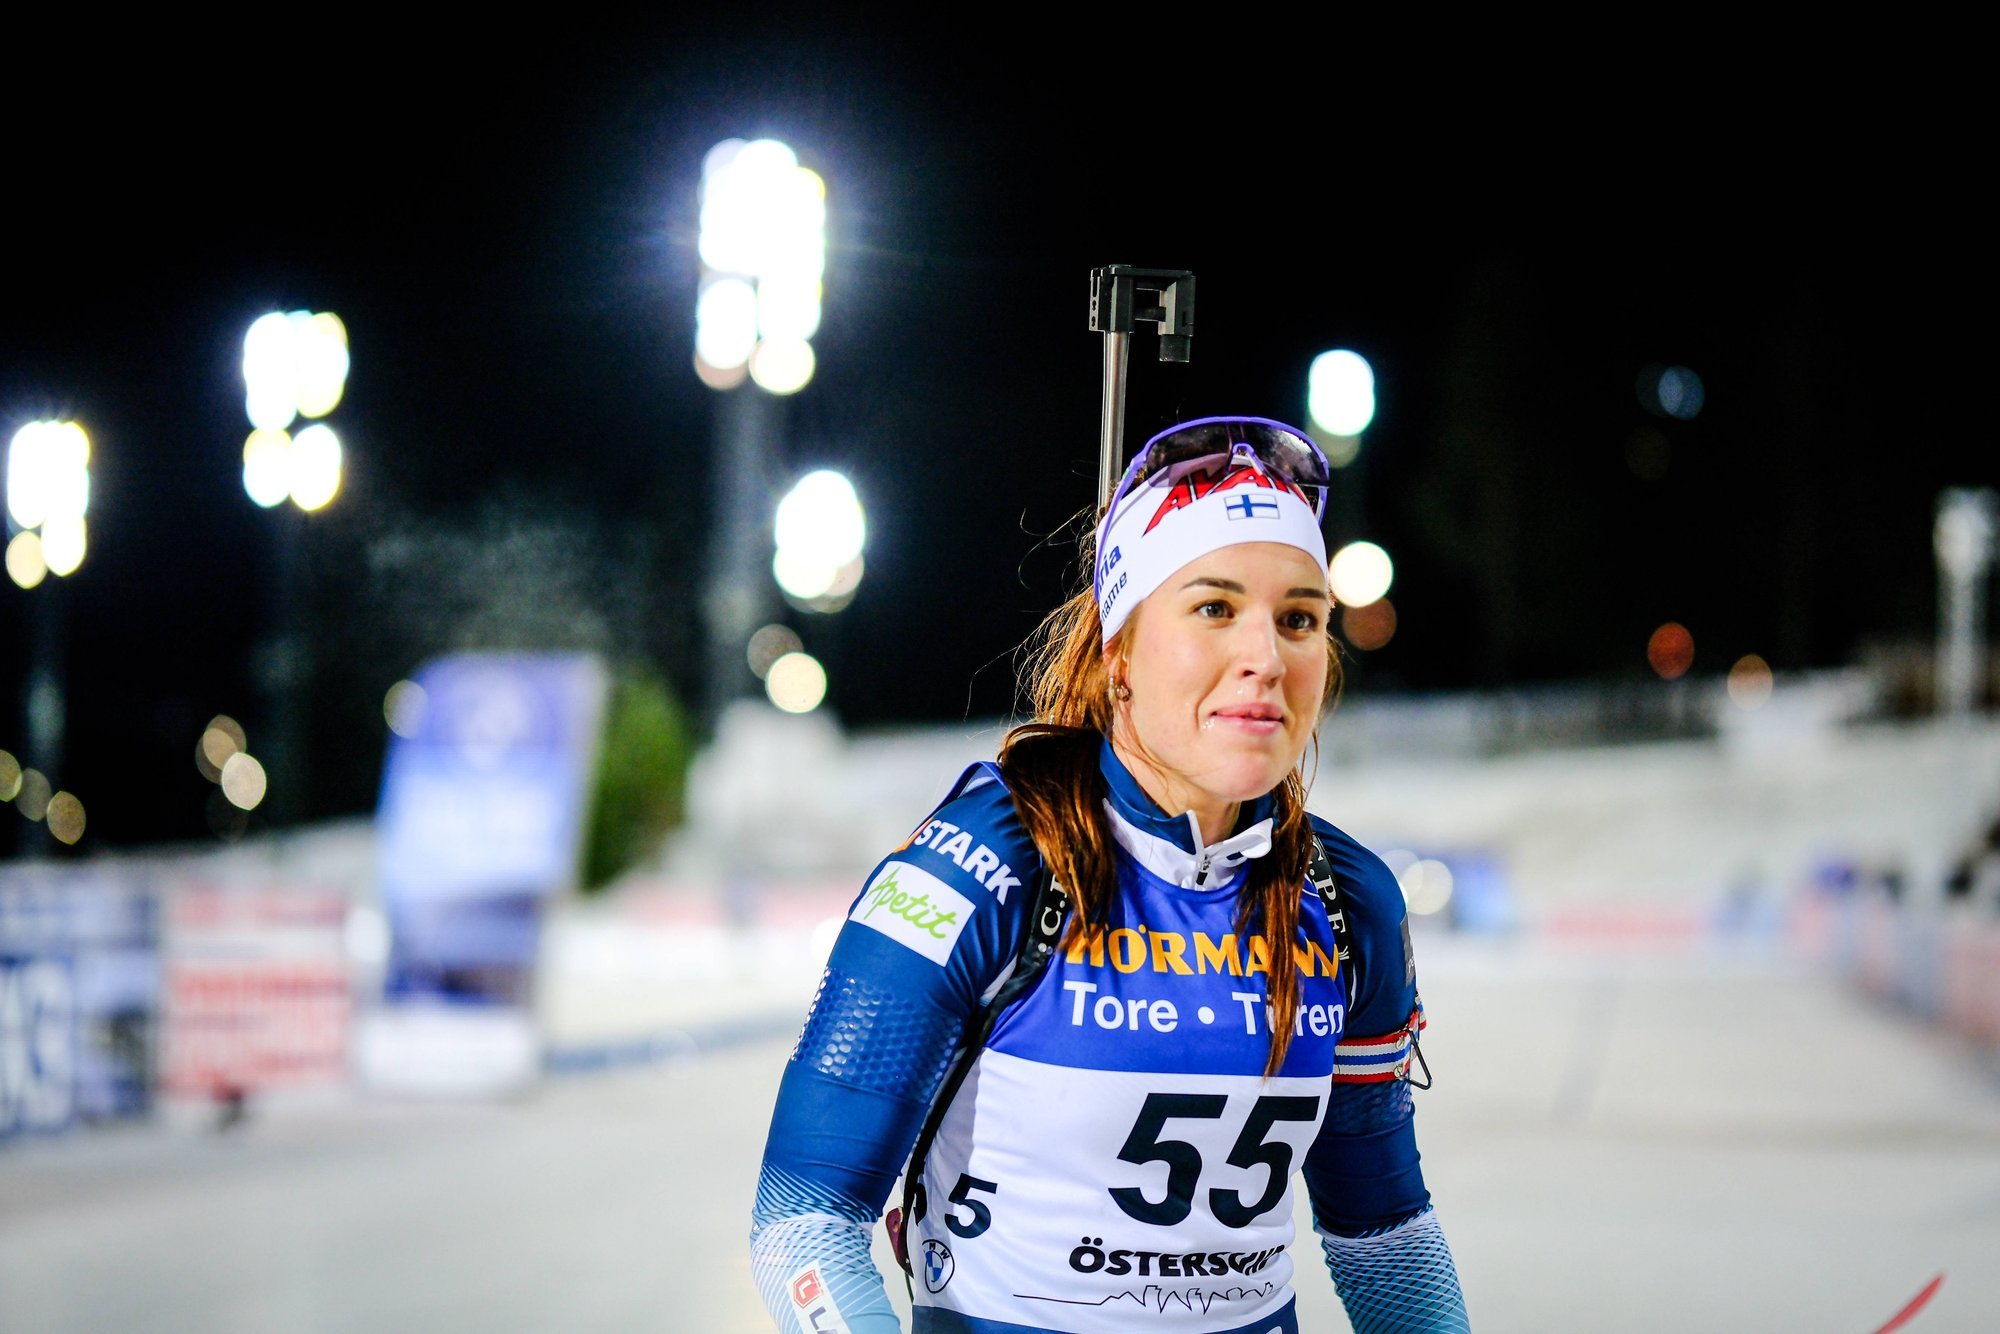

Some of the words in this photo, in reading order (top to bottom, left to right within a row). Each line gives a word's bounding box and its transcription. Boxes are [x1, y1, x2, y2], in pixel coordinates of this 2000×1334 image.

[861, 866, 957, 939] Apetit
[914, 819, 1022, 906] STARK
[1063, 981, 1179, 1033] Tore
[1232, 991, 1344, 1037] Tren
[1108, 1092, 1321, 1229] 55
